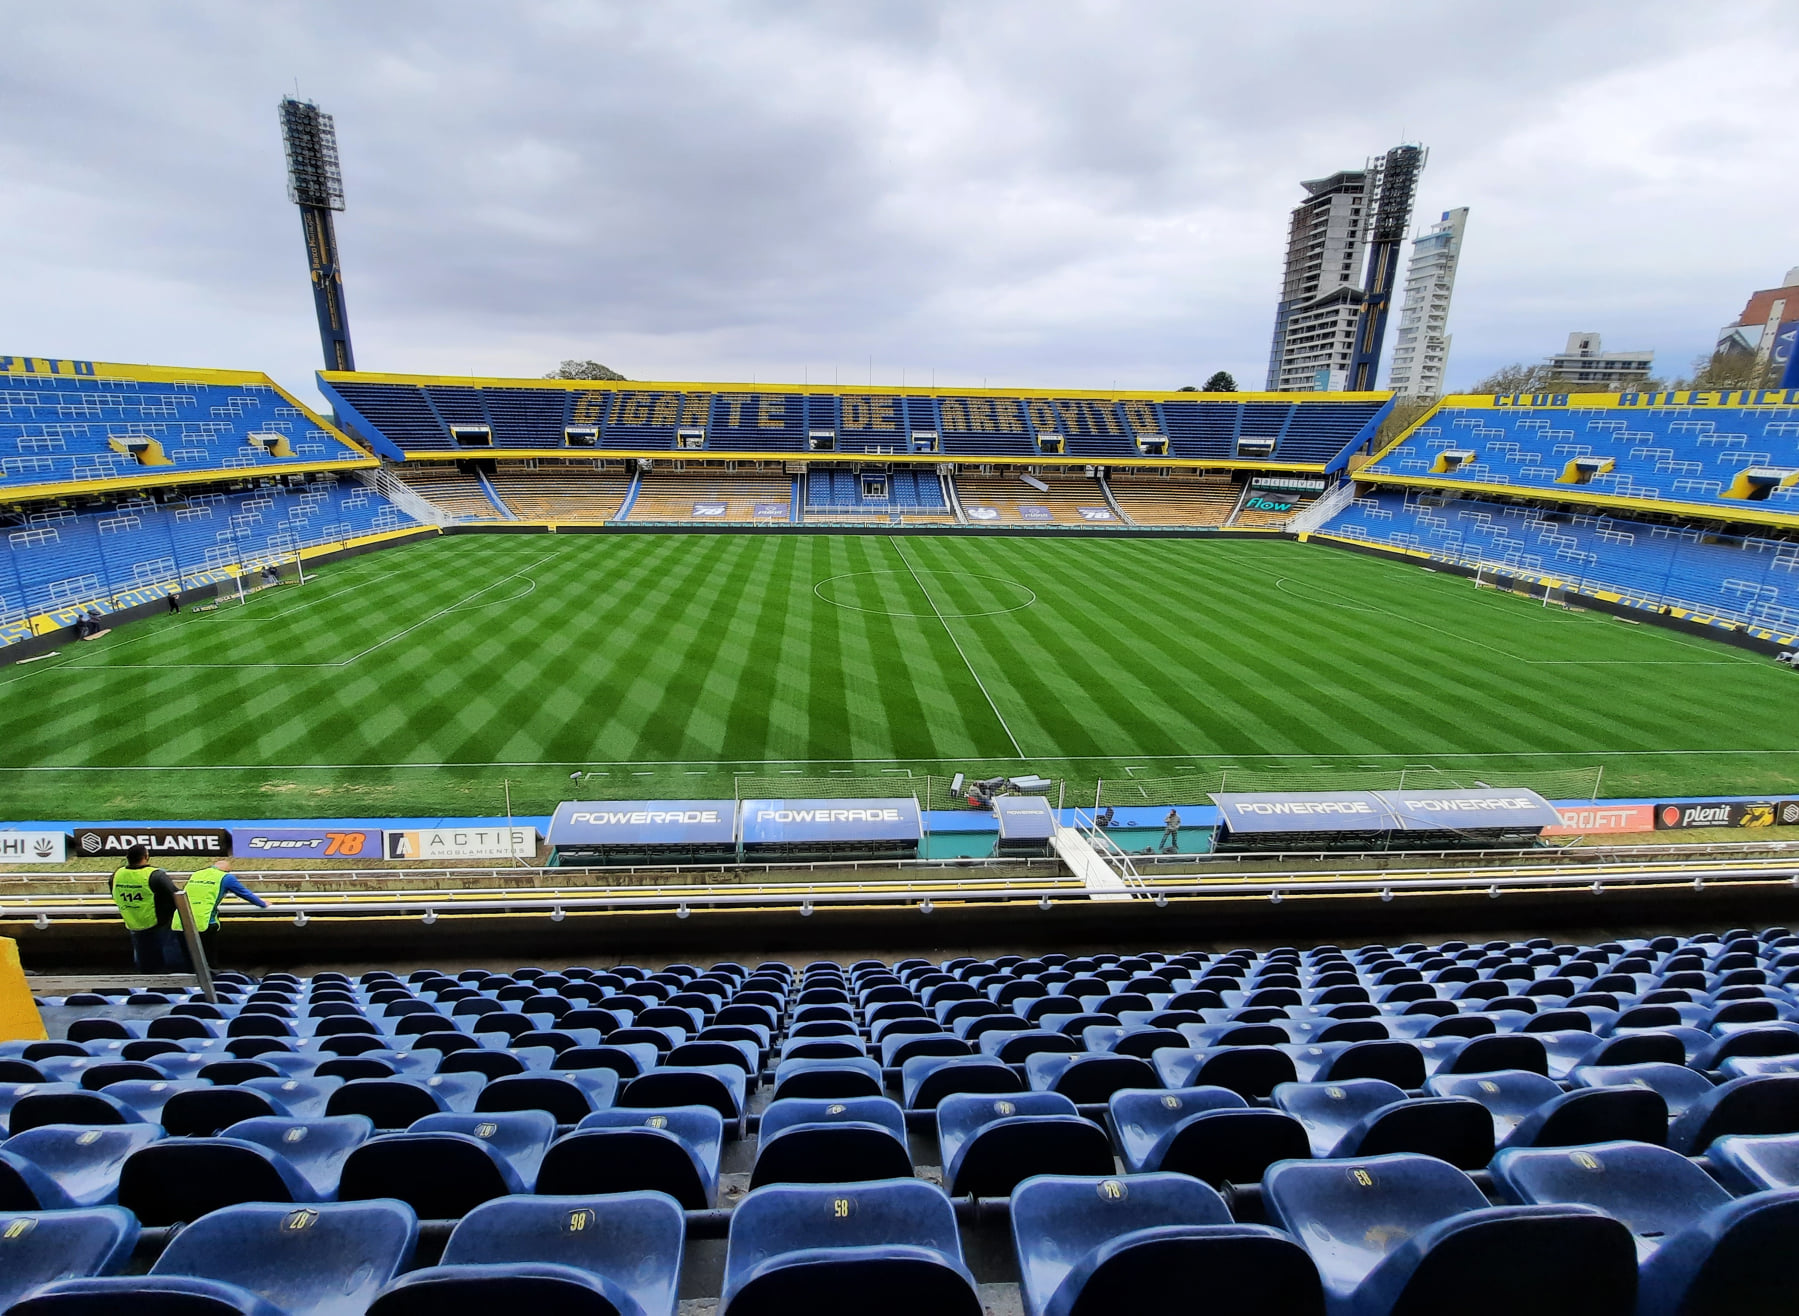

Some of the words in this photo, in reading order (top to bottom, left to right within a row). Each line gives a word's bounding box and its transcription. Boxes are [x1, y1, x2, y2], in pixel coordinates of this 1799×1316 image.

[1493, 393, 1569, 407] CLUB
[573, 390, 785, 428] GIGANTE
[842, 395, 897, 431] DE
[941, 398, 1159, 434] ARROYITO
[1246, 497, 1291, 511] flow
[50, 569, 232, 628] GUERREROS
[1235, 802, 1372, 814] POWERADE
[1404, 798, 1537, 811] POWERADE
[570, 811, 718, 824] POWERADE
[757, 809, 899, 822] POWERADE
[1547, 810, 1638, 829] ROFIT
[1682, 805, 1731, 827] plenit
[0, 839, 25, 854] HI
[105, 835, 220, 850] ADELANTE
[249, 837, 323, 850] Sport
[324, 832, 366, 856] 78
[430, 832, 524, 846] ACTIS
[120, 892, 144, 902] 114
[1353, 1169, 1372, 1186] 83
[1104, 1180, 1121, 1199] 84
[835, 1199, 848, 1217] 85
[290, 1208, 308, 1229] 87
[570, 1211, 587, 1231] 86
